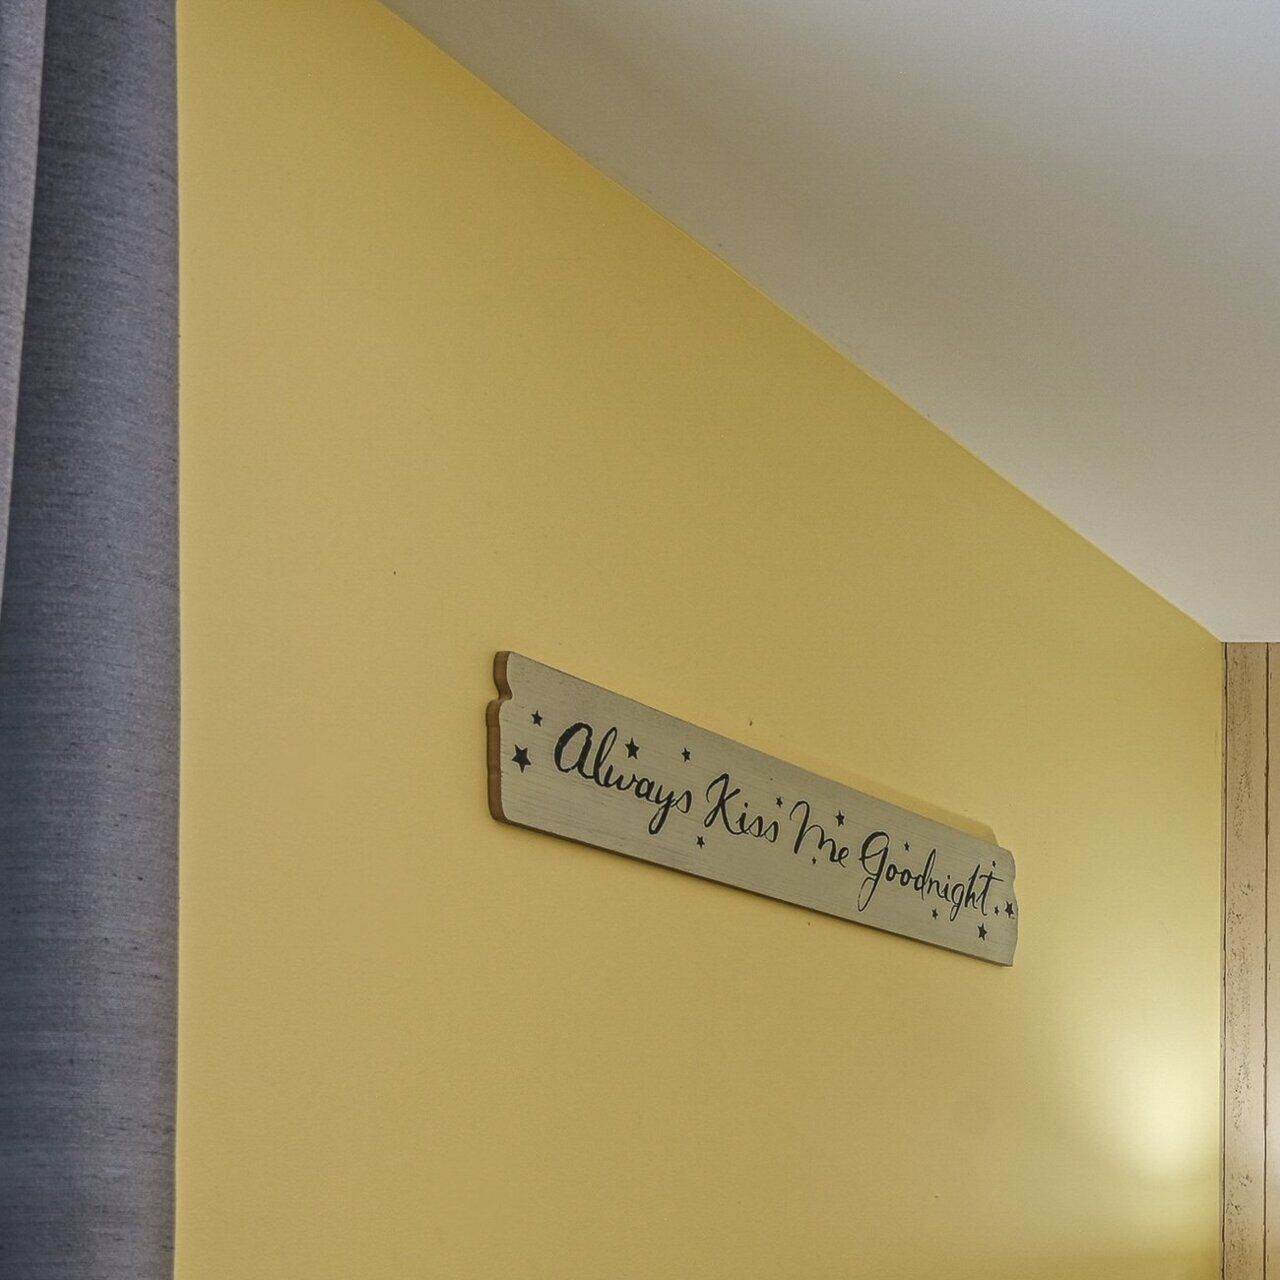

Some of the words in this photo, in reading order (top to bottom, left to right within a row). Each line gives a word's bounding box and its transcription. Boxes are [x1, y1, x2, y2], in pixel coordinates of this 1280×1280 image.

[553, 721, 693, 835] Always
[703, 772, 779, 844] Kiss
[789, 800, 850, 867] Me
[857, 829, 1003, 921] Goodnight
